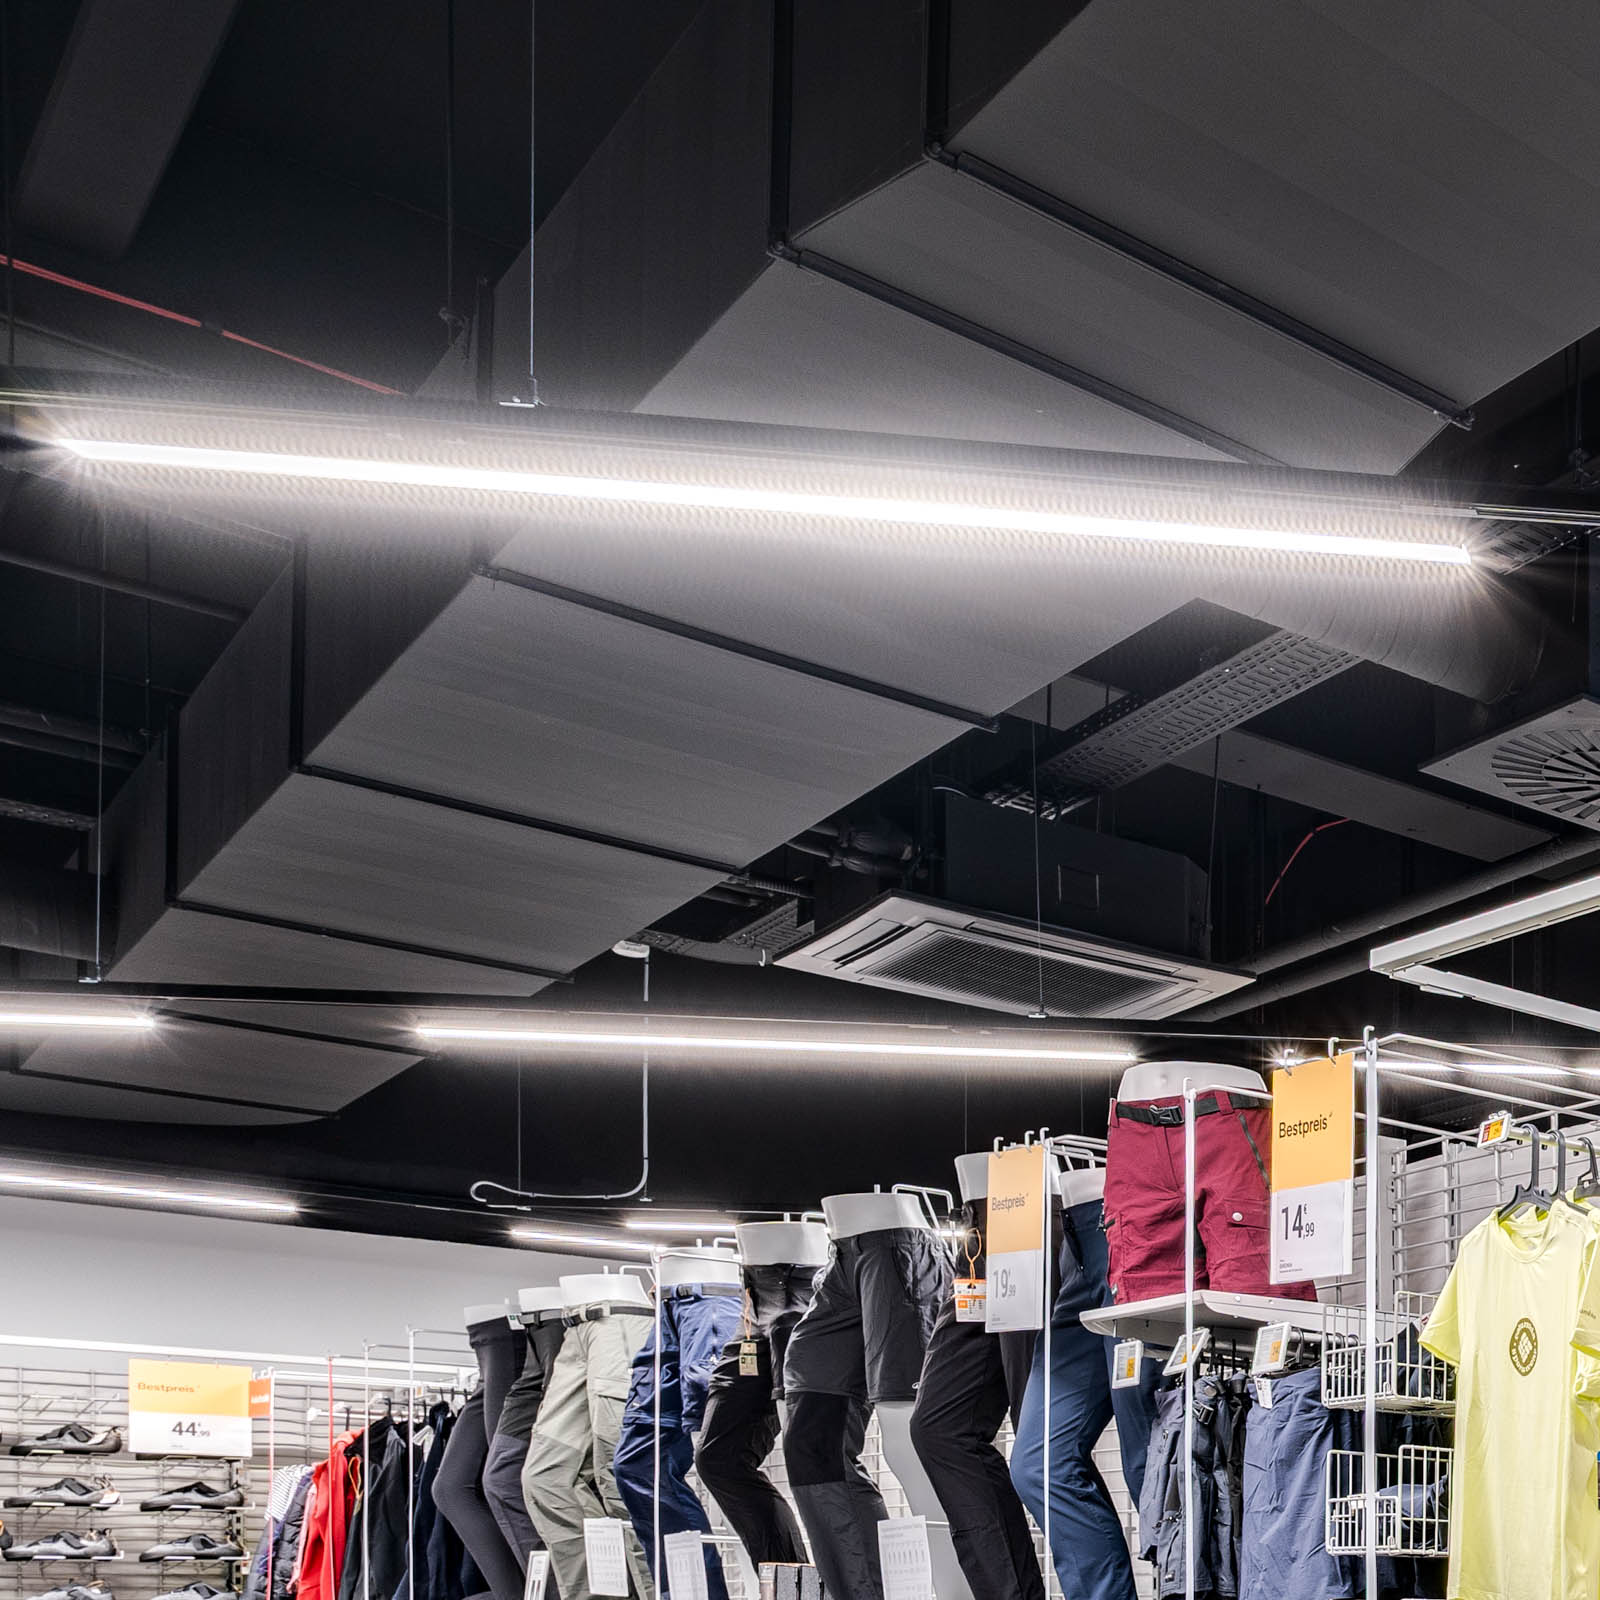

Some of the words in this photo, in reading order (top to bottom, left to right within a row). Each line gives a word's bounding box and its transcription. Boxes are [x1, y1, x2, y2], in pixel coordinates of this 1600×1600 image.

[1279, 1114, 1328, 1139] Bestpreis
[991, 1193, 1026, 1214] Bestpreis
[138, 1382, 196, 1393] Bestpreis
